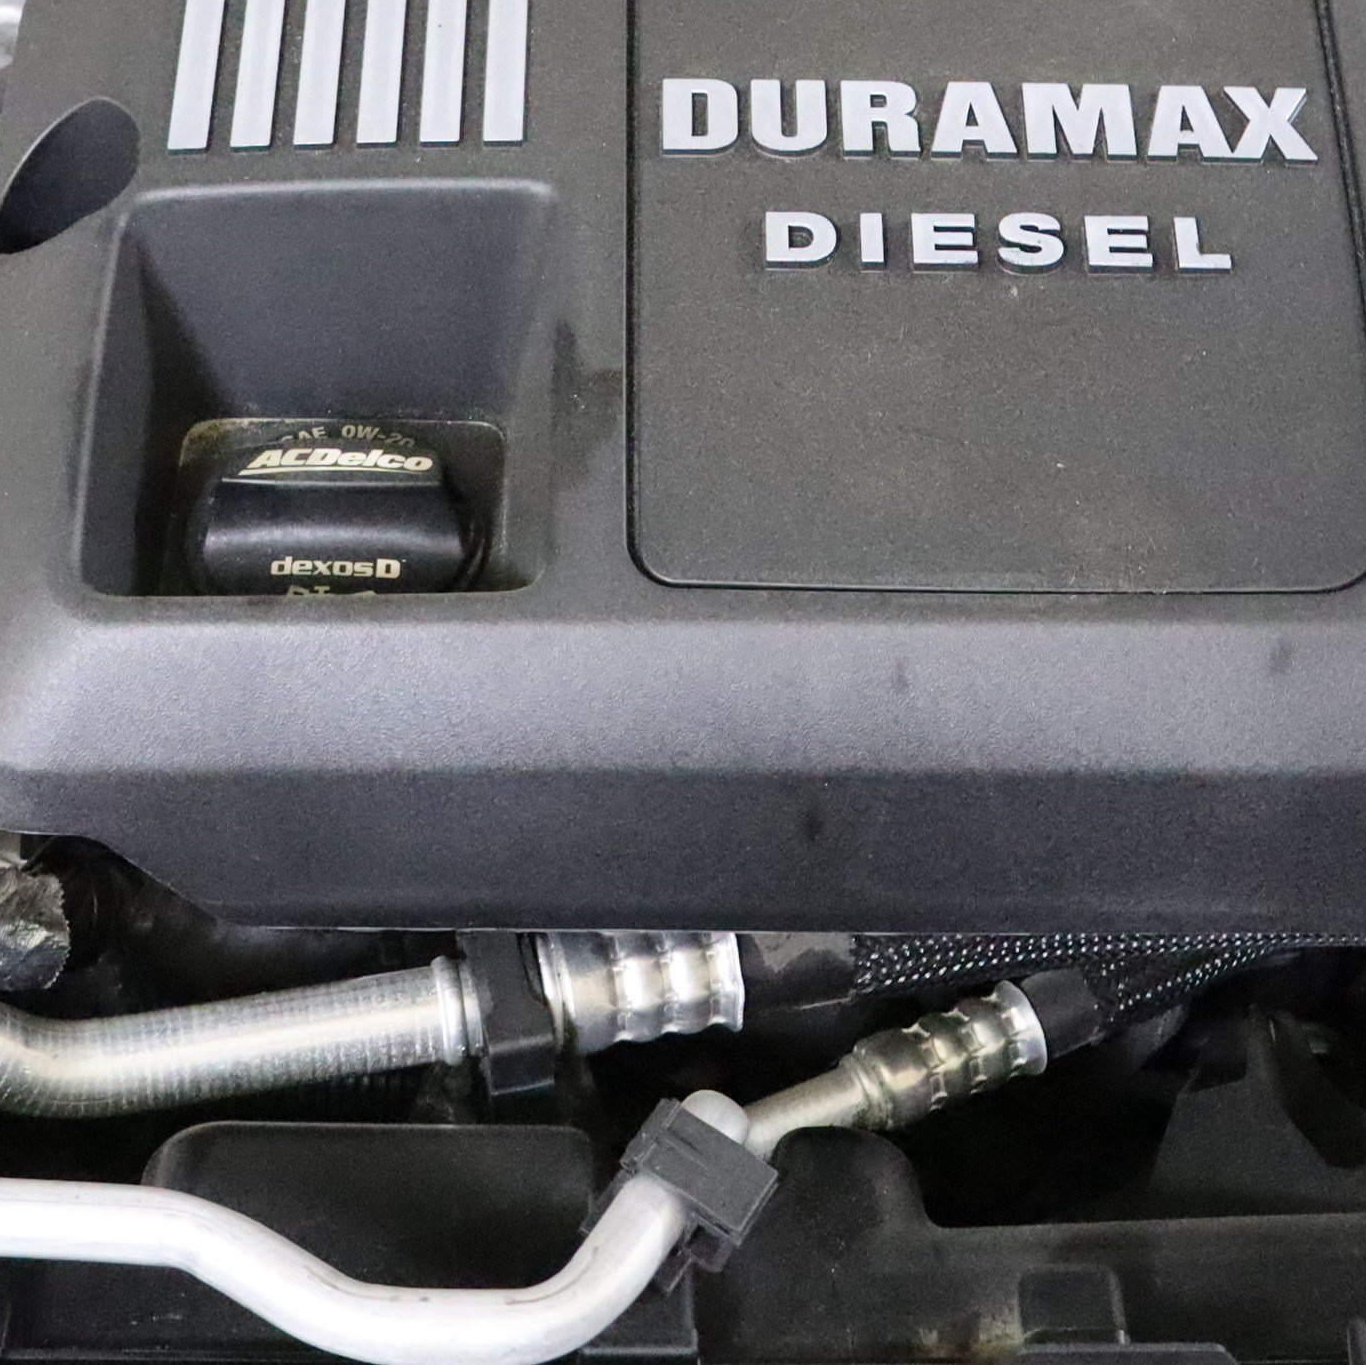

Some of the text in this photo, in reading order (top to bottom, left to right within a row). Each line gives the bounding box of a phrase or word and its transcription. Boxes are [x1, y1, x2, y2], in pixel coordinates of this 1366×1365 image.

[662, 78, 1319, 160] DURAMAX
[765, 211, 1232, 272] DIESEL
[246, 447, 433, 472] ACDelco
